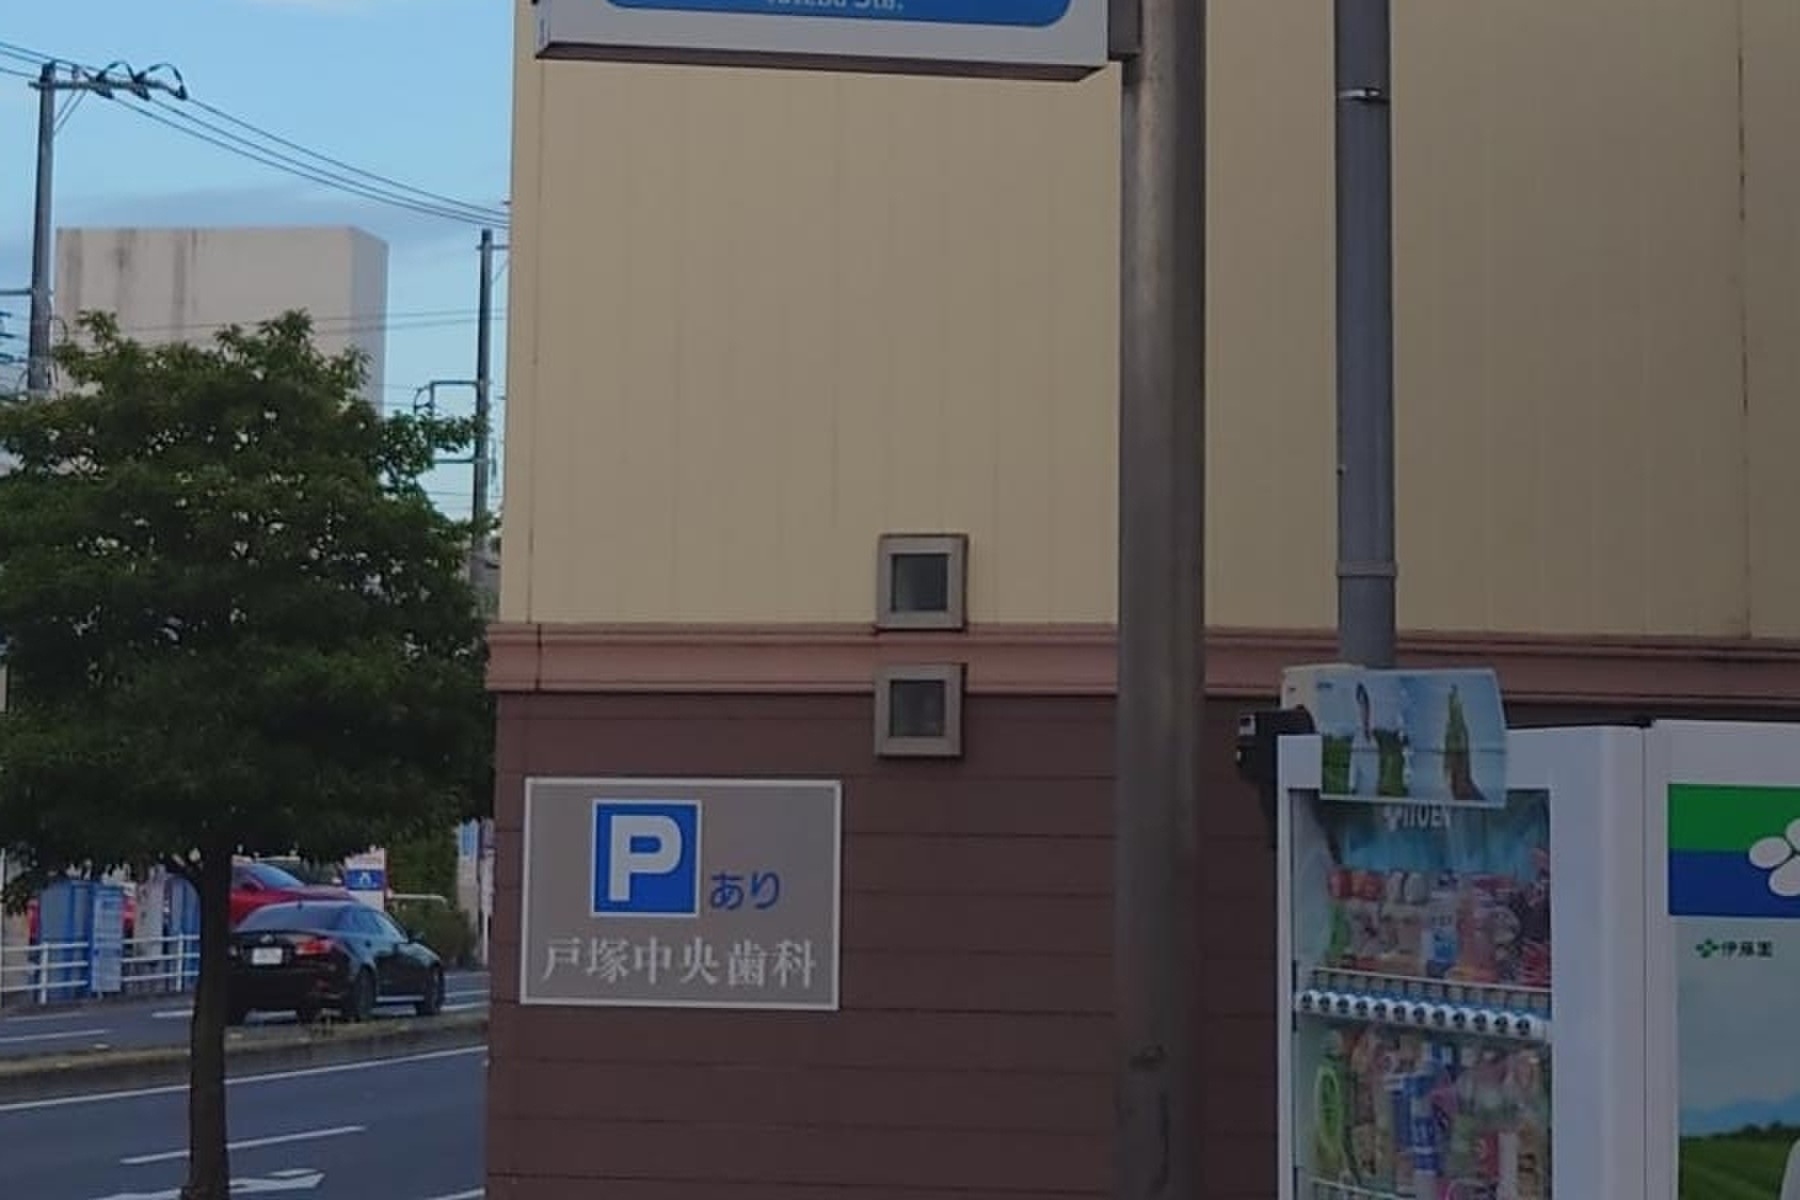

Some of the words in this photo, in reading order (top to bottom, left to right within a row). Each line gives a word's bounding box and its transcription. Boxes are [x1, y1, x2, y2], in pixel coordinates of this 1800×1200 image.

[608, 815, 682, 902] P
[710, 871, 781, 910] あり
[542, 936, 816, 988] 戸塚中央歯科
